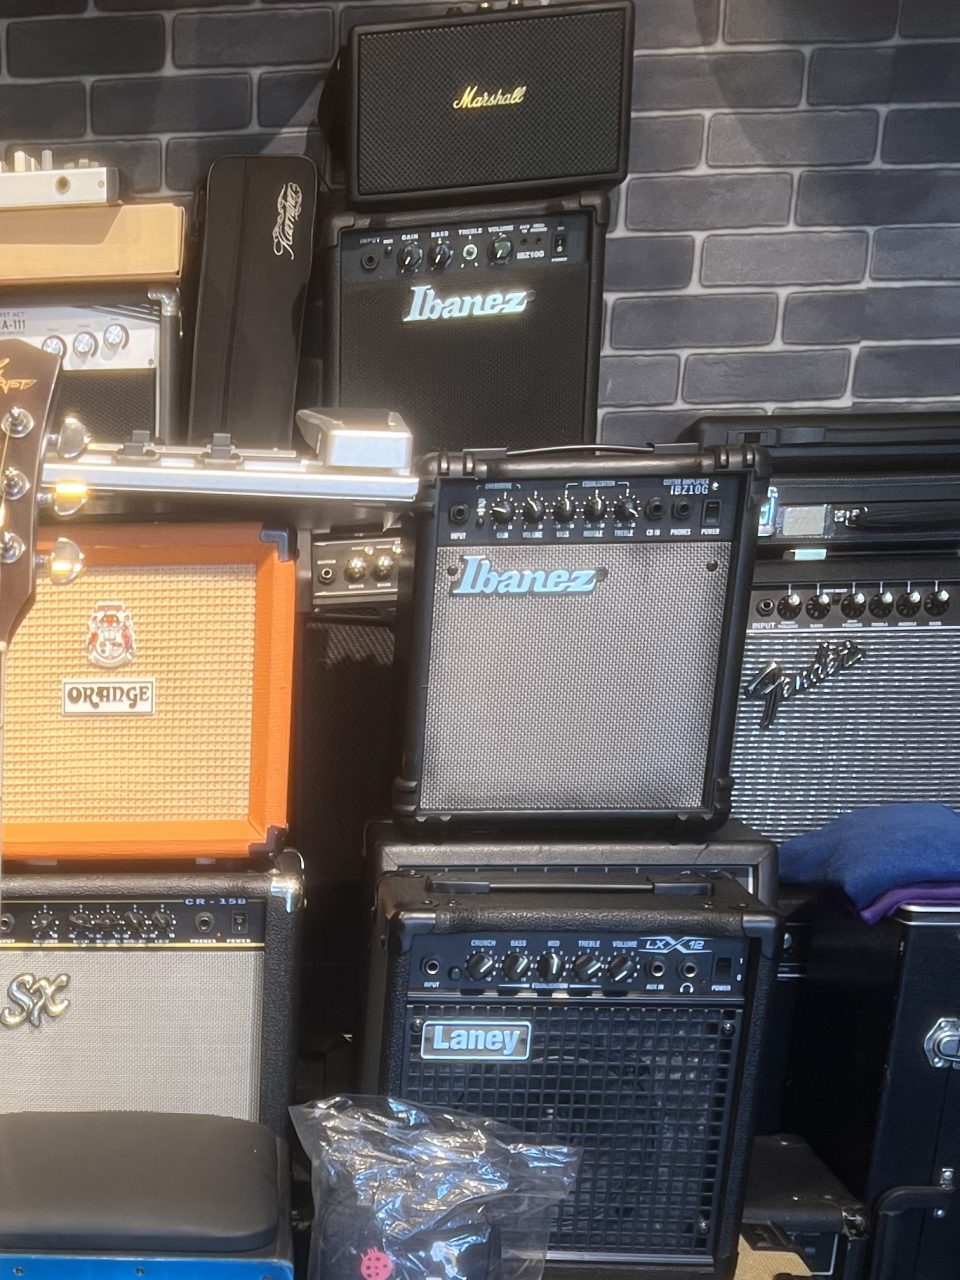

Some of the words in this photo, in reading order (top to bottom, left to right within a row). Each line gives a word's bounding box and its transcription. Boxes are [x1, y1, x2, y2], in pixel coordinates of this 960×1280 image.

[452, 86, 527, 109] Marshall
[401, 233, 419, 241] GAIN
[402, 285, 528, 322] Ibanez
[670, 485, 709, 496] IBZ10G
[452, 555, 600, 594] Ibanez
[752, 622, 775, 630] INPUT
[67, 686, 150, 709] ORANGE
[470, 939, 496, 947] CRUNCH
[510, 939, 527, 947] BASS
[578, 940, 601, 948] TREBLE
[612, 940, 638, 948] VOLUME
[433, 1025, 520, 1056] Laney
